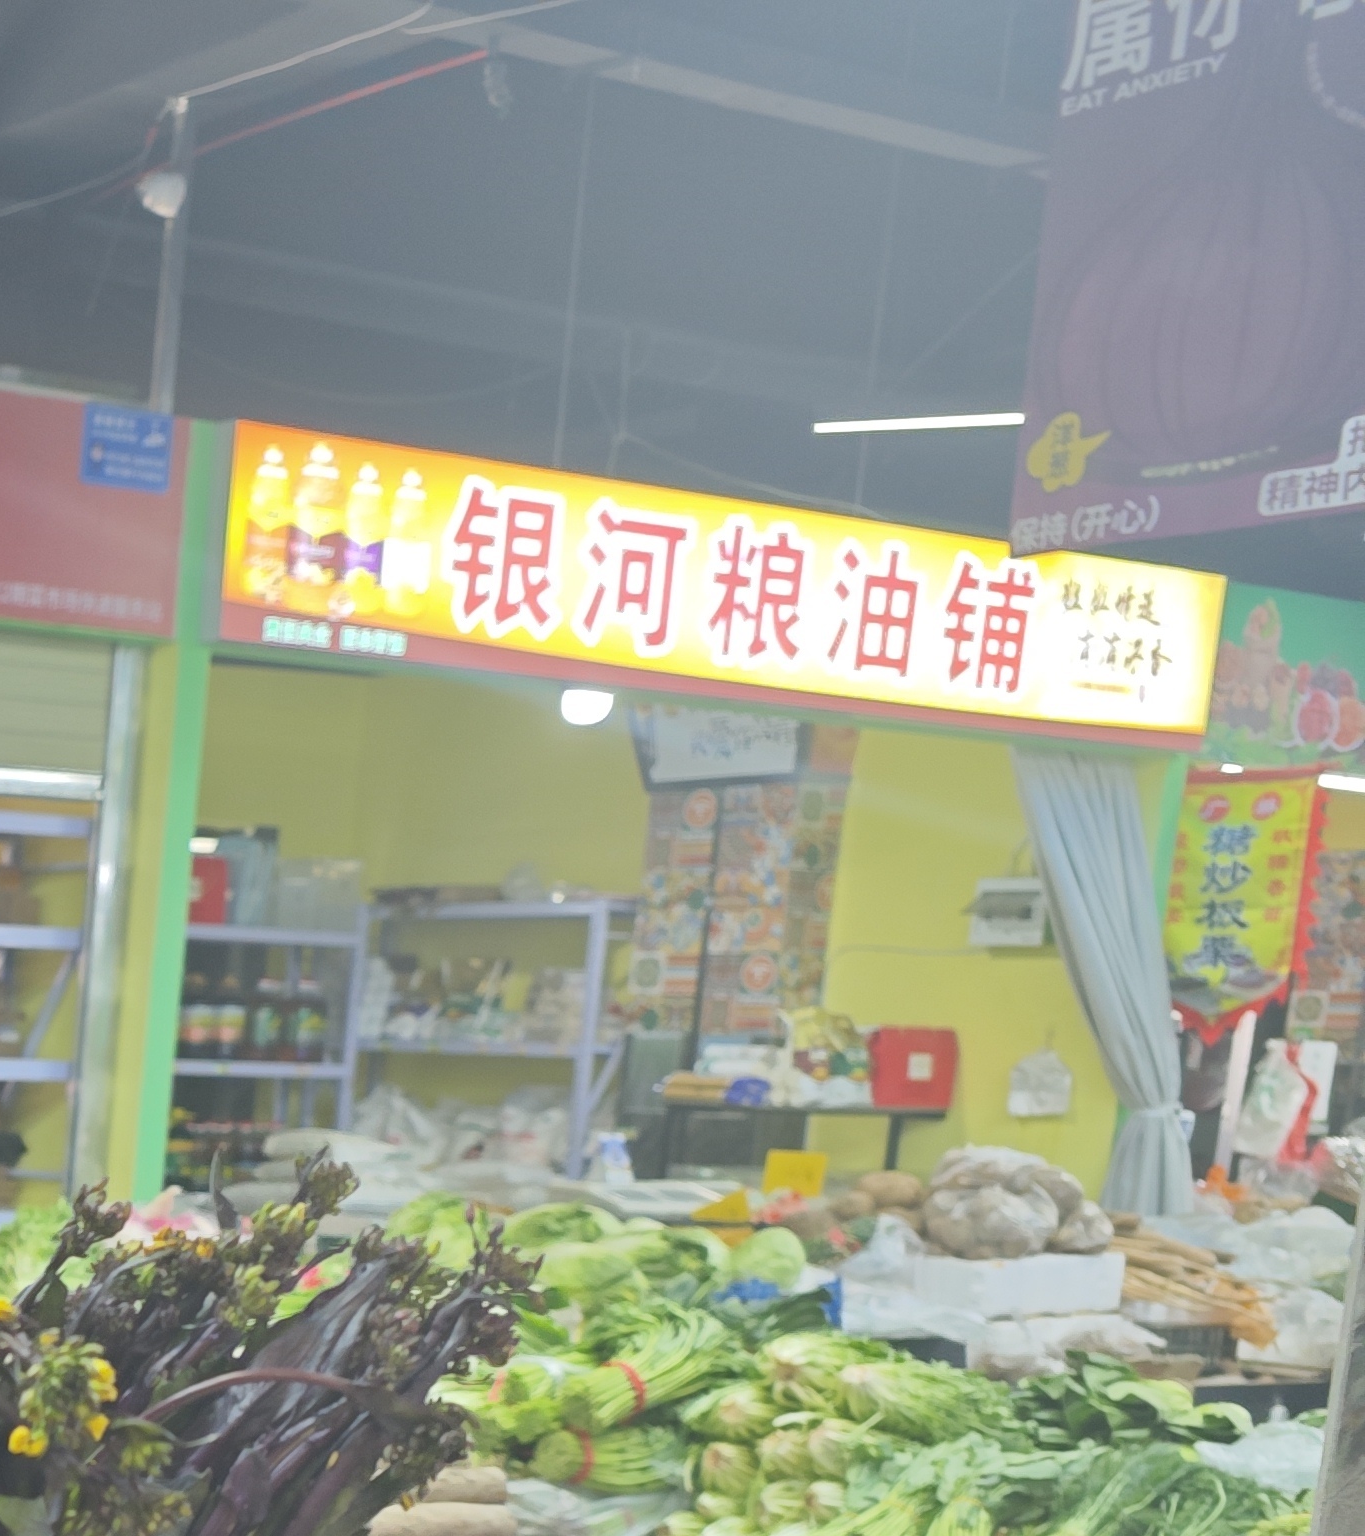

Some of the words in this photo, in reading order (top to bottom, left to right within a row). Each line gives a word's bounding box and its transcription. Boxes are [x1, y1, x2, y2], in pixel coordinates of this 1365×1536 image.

[1060, 88, 1109, 118] EAT
[1112, 52, 1228, 103] ANXIETY
[449, 479, 1041, 696] 银河粮油铺
[1195, 823, 1259, 968] 糖炒板栗
